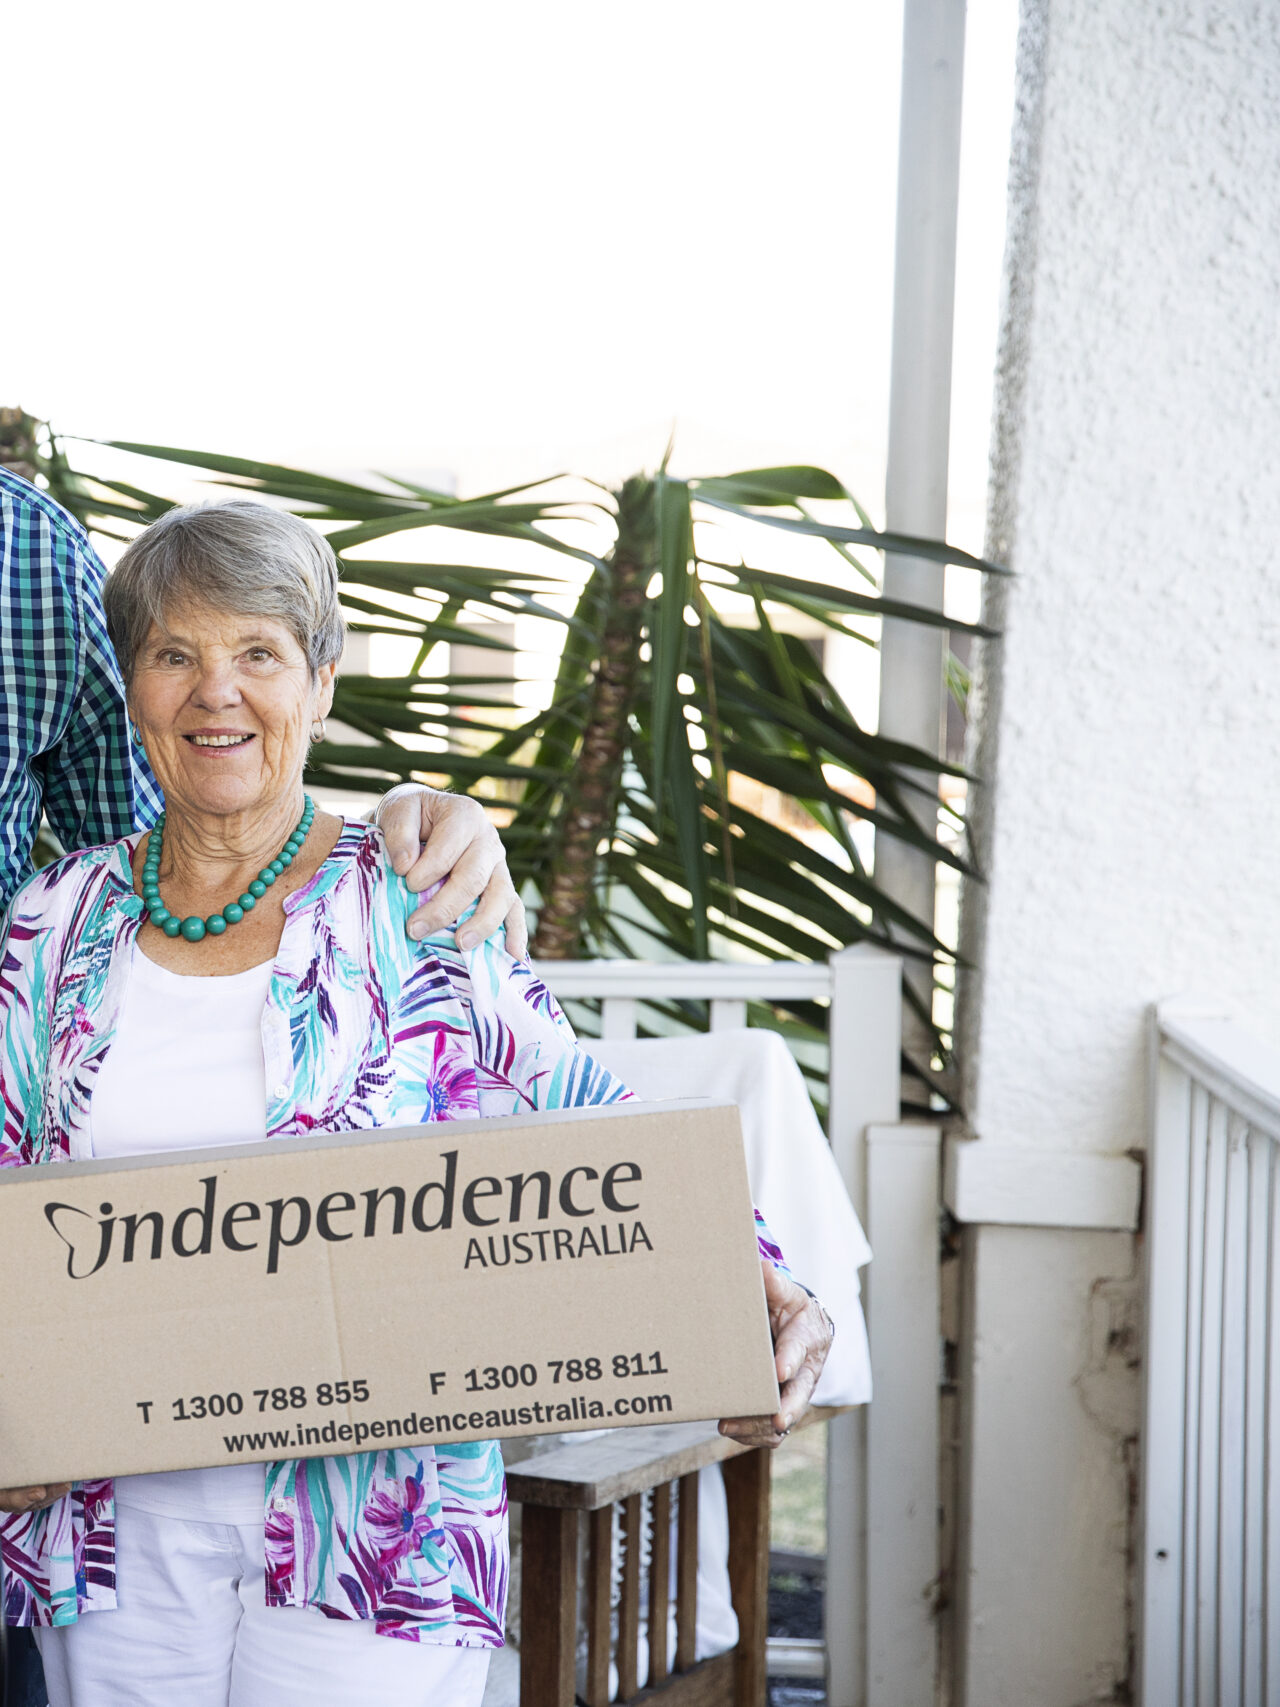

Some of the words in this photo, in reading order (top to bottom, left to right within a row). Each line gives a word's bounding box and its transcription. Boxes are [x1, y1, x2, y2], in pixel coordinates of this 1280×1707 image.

[44, 1151, 642, 1279] independence
[464, 1221, 654, 1269] AUSTRALIA
[429, 1371, 446, 1395] F
[464, 1363, 538, 1392] 1300
[547, 1357, 603, 1384] 788
[612, 1351, 668, 1378] 811
[136, 1401, 153, 1424] T
[172, 1392, 244, 1421] 1300
[253, 1387, 307, 1412] 788
[316, 1379, 370, 1406] 855
[223, 1391, 673, 1454] www.independenceaustralia.com
